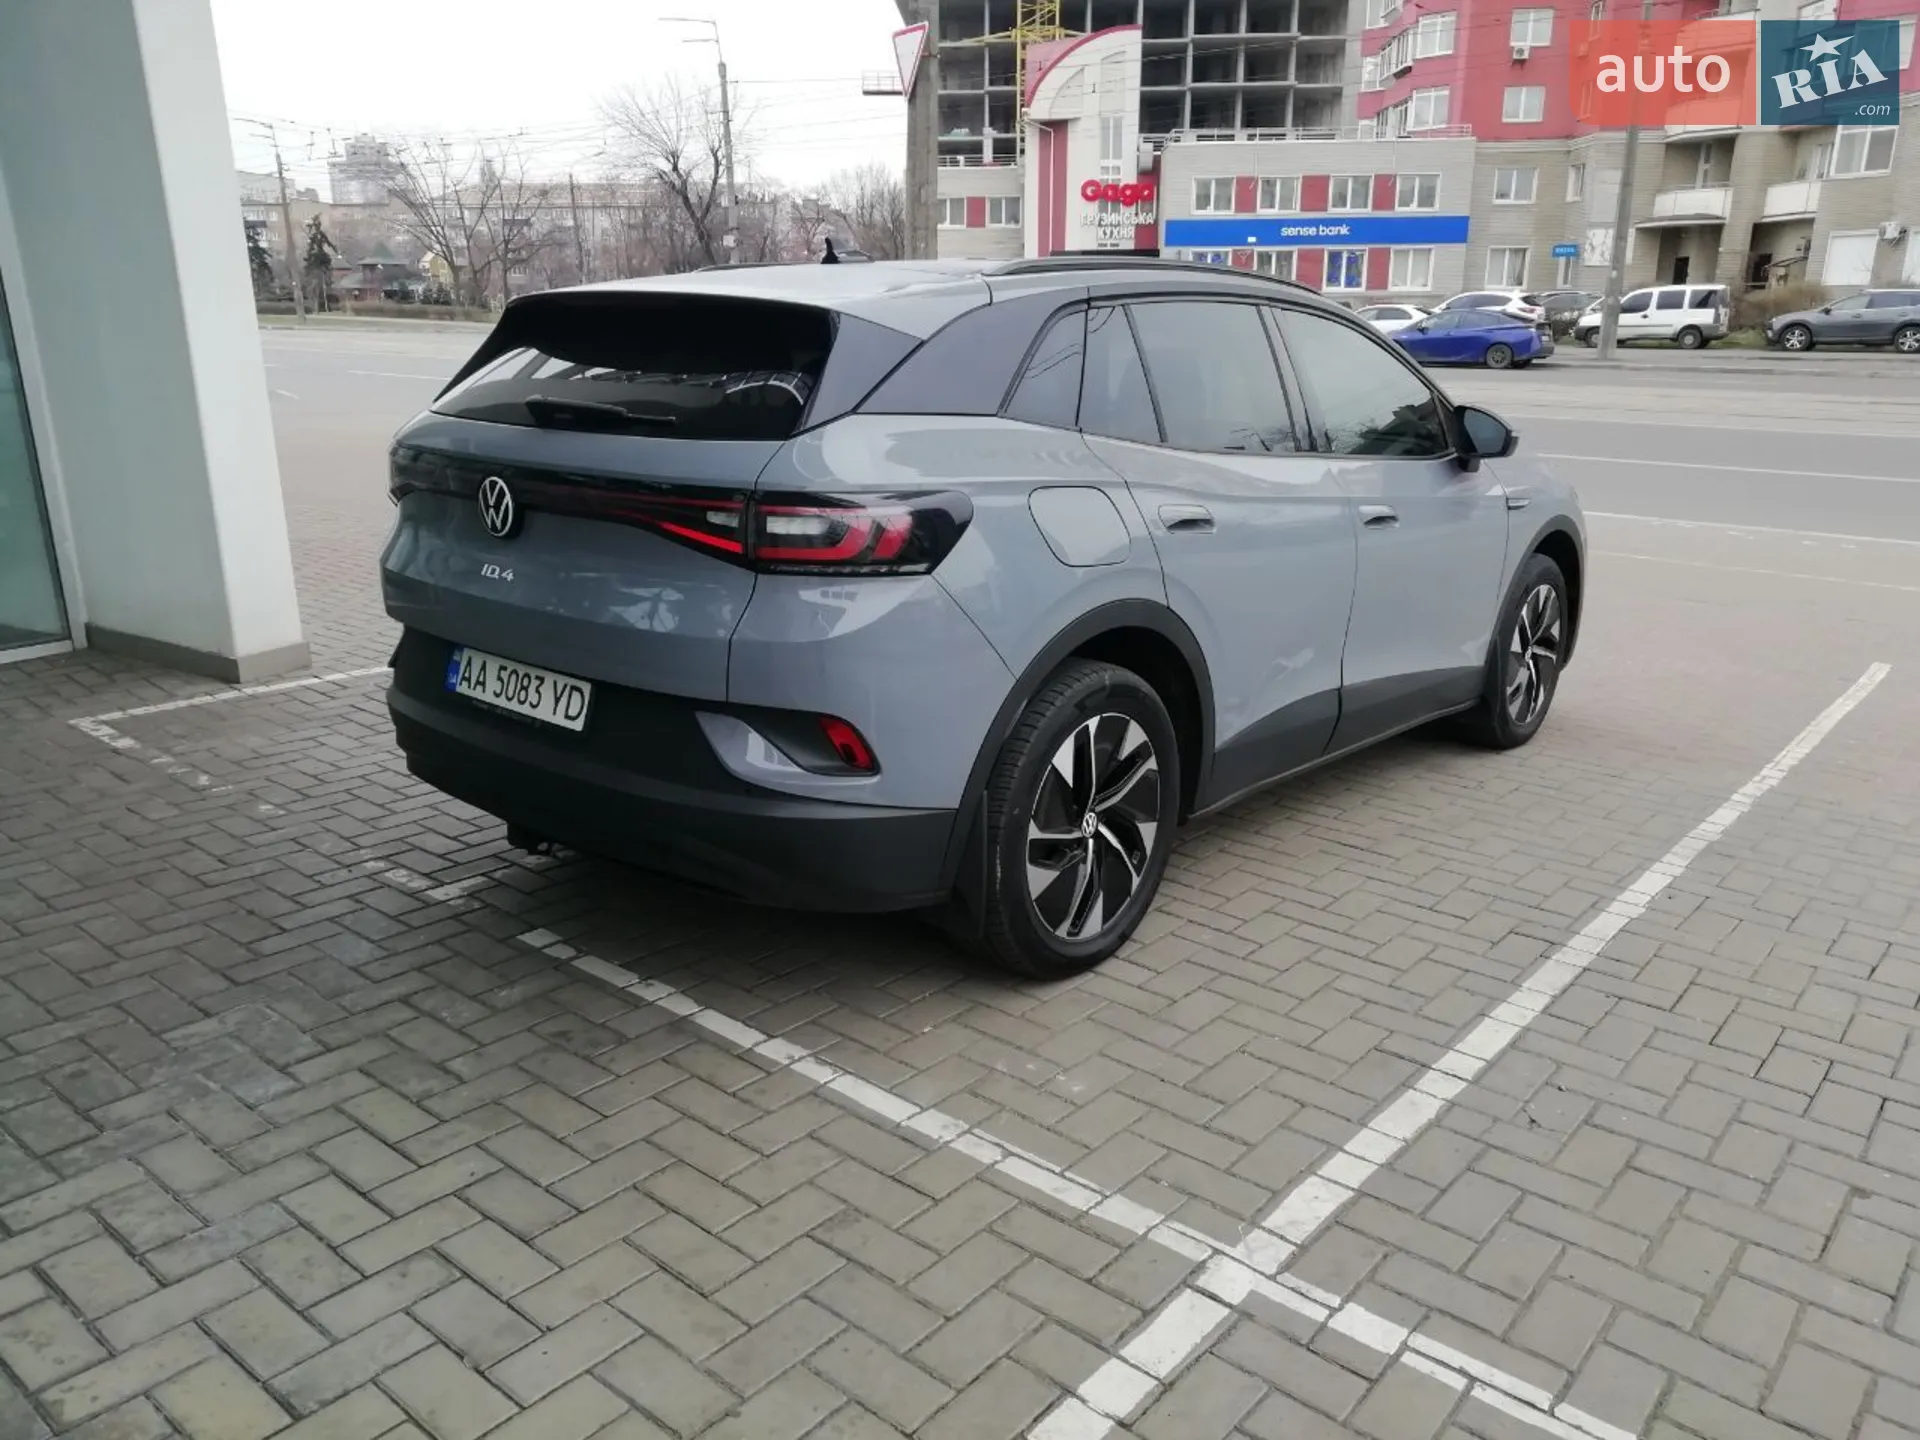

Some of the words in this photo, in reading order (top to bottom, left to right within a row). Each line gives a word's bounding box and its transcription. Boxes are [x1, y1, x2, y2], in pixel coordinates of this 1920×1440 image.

[1081, 179, 1154, 207] Gaga
[1081, 212, 1154, 226] ГРУЗИНСЬКА
[1098, 226, 1135, 240] КУХНЯ
[1280, 225, 1317, 236] sense
[1319, 223, 1350, 235] bank
[459, 655, 487, 694] AA
[493, 664, 546, 710] 5083
[552, 679, 586, 722] YD
